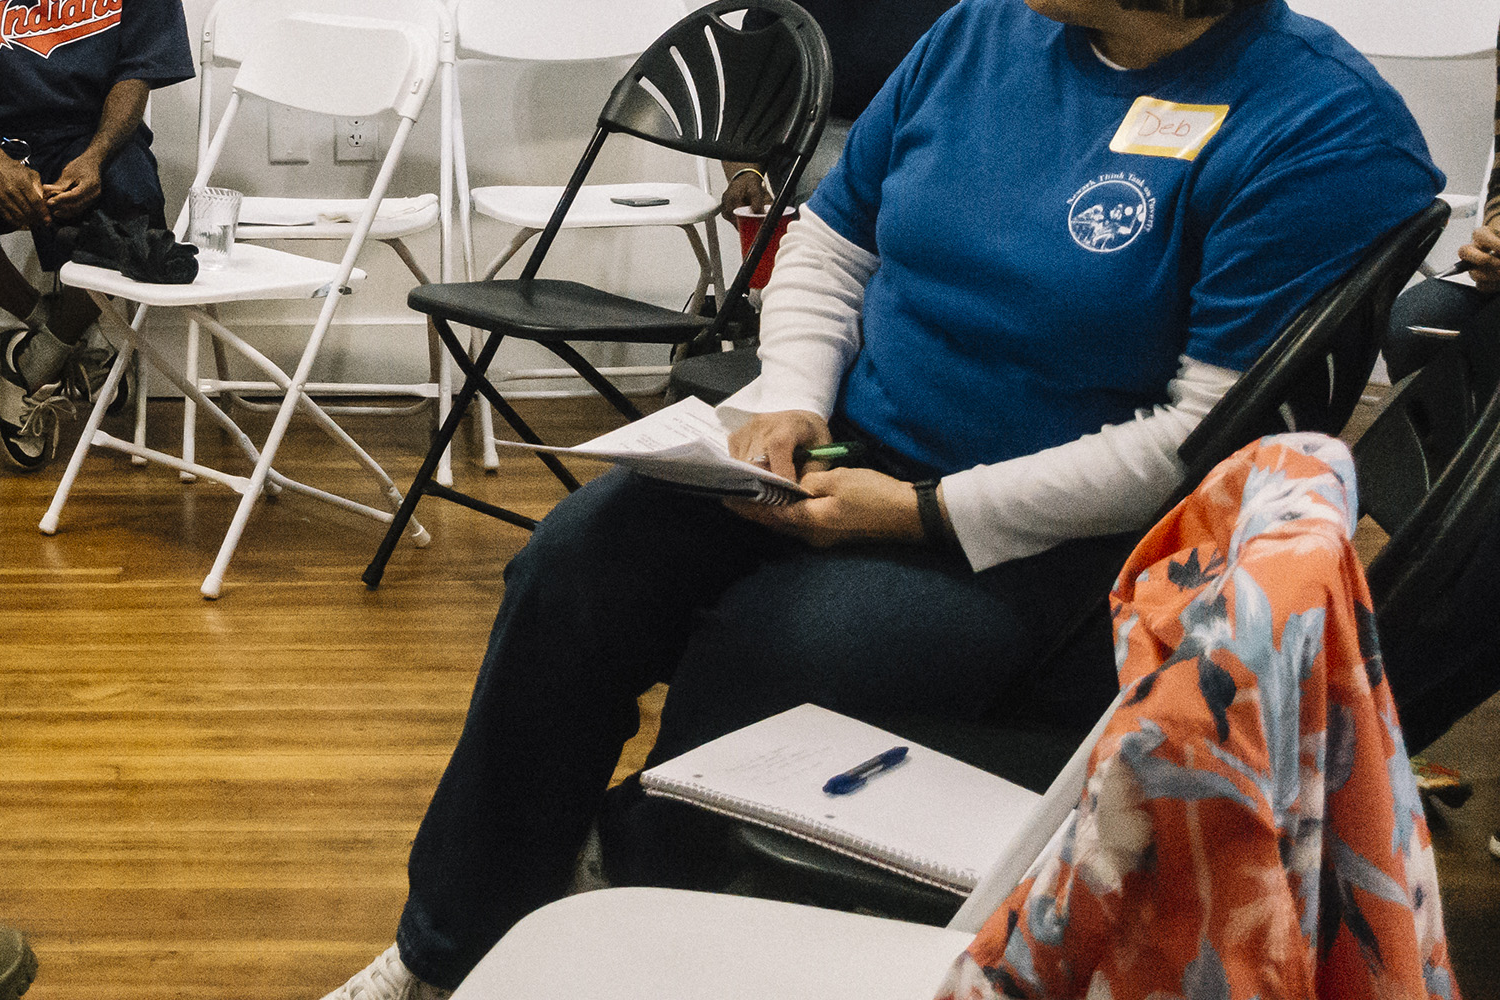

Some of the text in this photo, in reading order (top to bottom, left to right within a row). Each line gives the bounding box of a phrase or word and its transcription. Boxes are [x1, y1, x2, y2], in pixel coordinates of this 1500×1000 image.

[1138, 111, 1191, 137] Deb
[1098, 172, 1125, 182] Think
[1128, 172, 1146, 188] Tank
